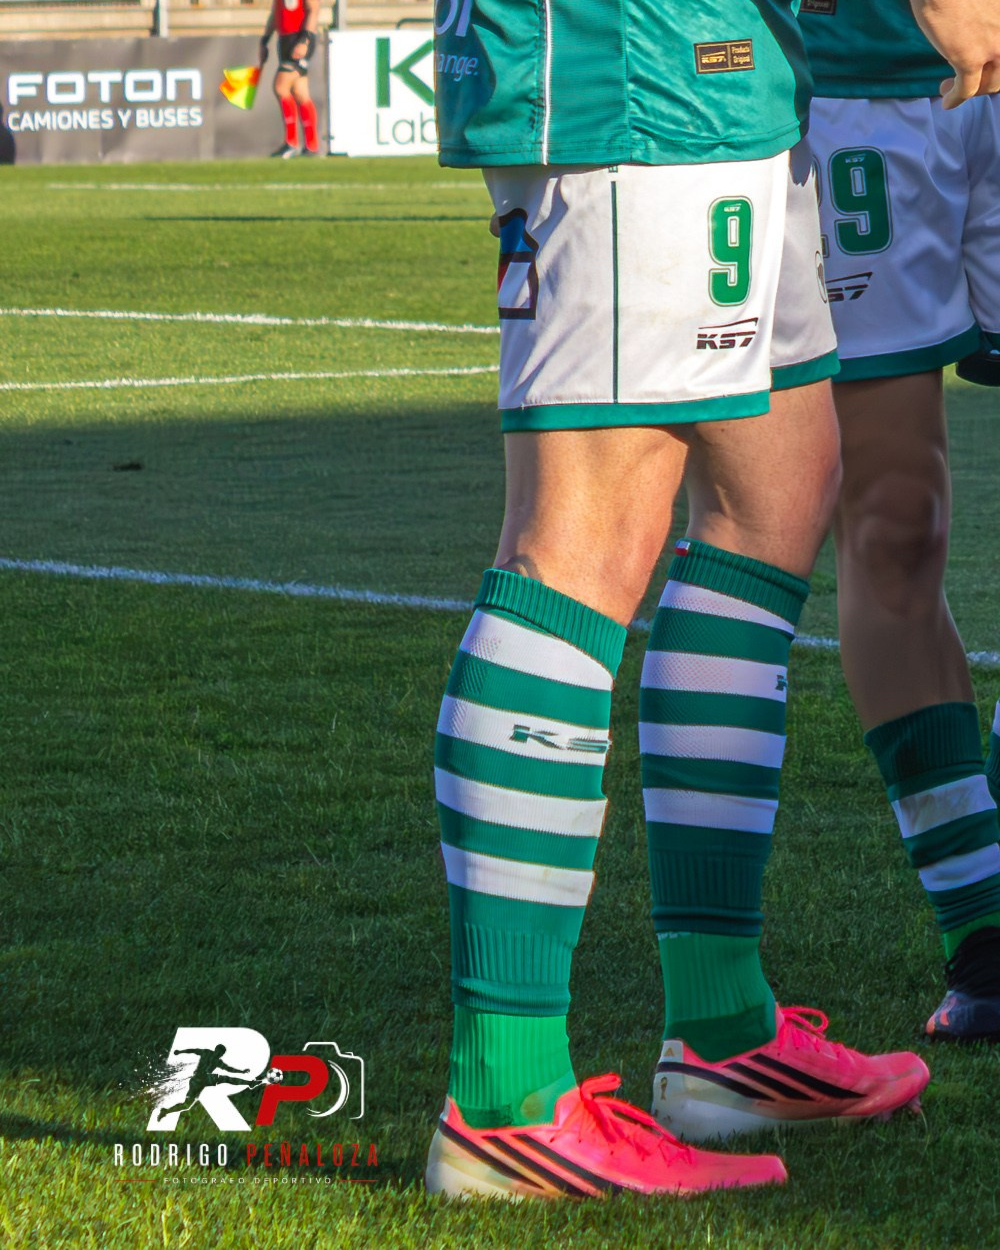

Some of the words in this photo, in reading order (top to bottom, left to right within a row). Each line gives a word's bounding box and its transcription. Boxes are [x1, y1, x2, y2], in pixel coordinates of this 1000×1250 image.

[8, 68, 202, 106] FOTON
[7, 108, 114, 132] CAMIONES
[117, 108, 132, 129] Y
[135, 106, 203, 129] BUSES
[708, 196, 754, 307] 9
